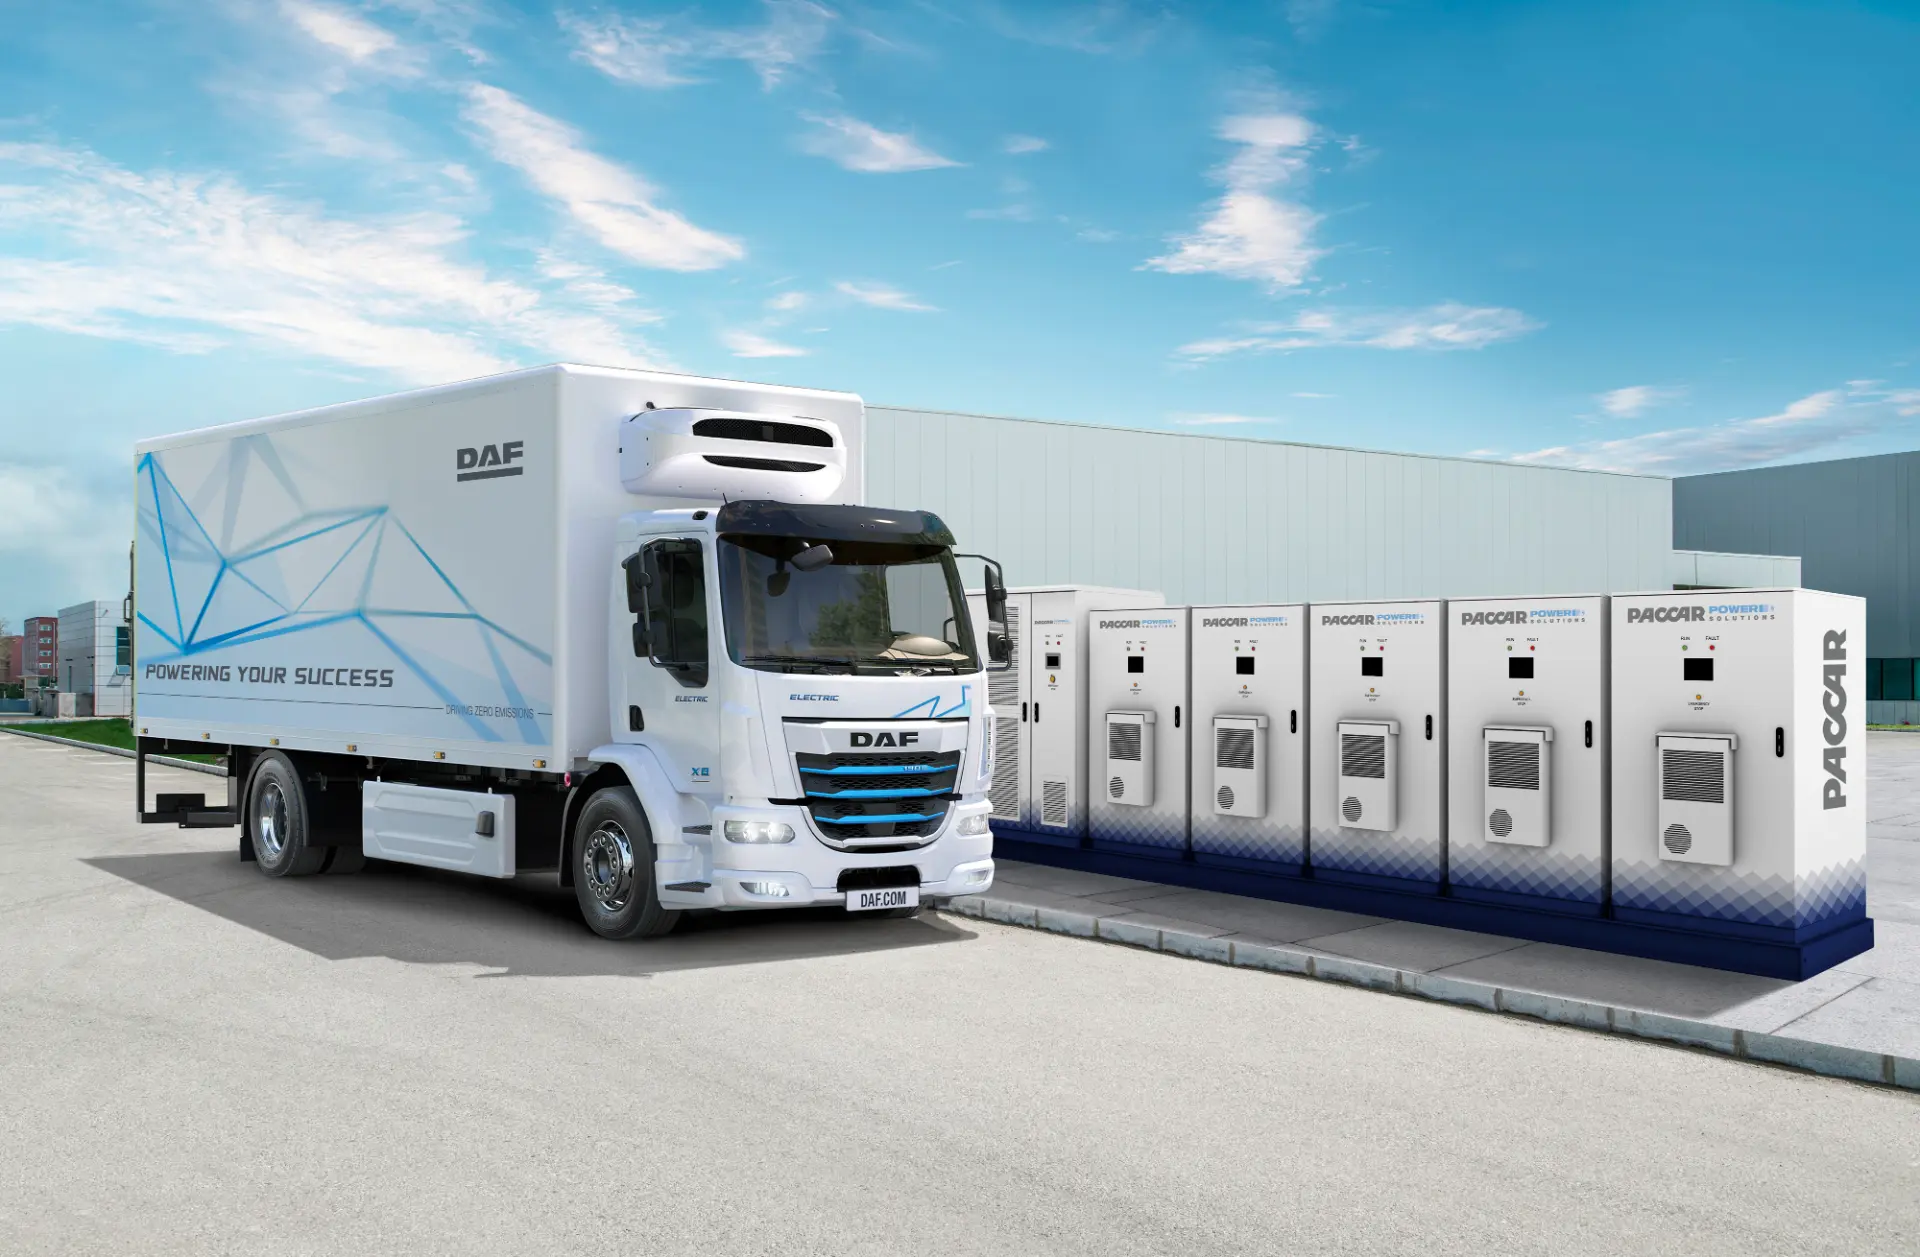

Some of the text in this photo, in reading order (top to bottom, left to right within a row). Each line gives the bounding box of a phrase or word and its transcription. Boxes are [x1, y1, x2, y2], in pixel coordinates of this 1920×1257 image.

[457, 440, 523, 469] DAF
[1321, 614, 1375, 626] PACCAR
[1461, 610, 1528, 626] PACCAR
[1627, 605, 1706, 623] PACCAR
[1708, 614, 1775, 622] SOLUTIONS
[1099, 619, 1141, 629] PACCAR
[1202, 617, 1249, 628] PACCAR
[145, 663, 395, 688] POWERING YOUR SUCCESS
[675, 695, 709, 703] ELECTRIC
[789, 693, 840, 702] ELECTRIC
[445, 704, 534, 719] DRIVING ZERO EMISSIONS
[1822, 629, 1847, 810] PACCAR
[850, 731, 919, 747] DAF
[860, 890, 907, 908] DAF.COM
